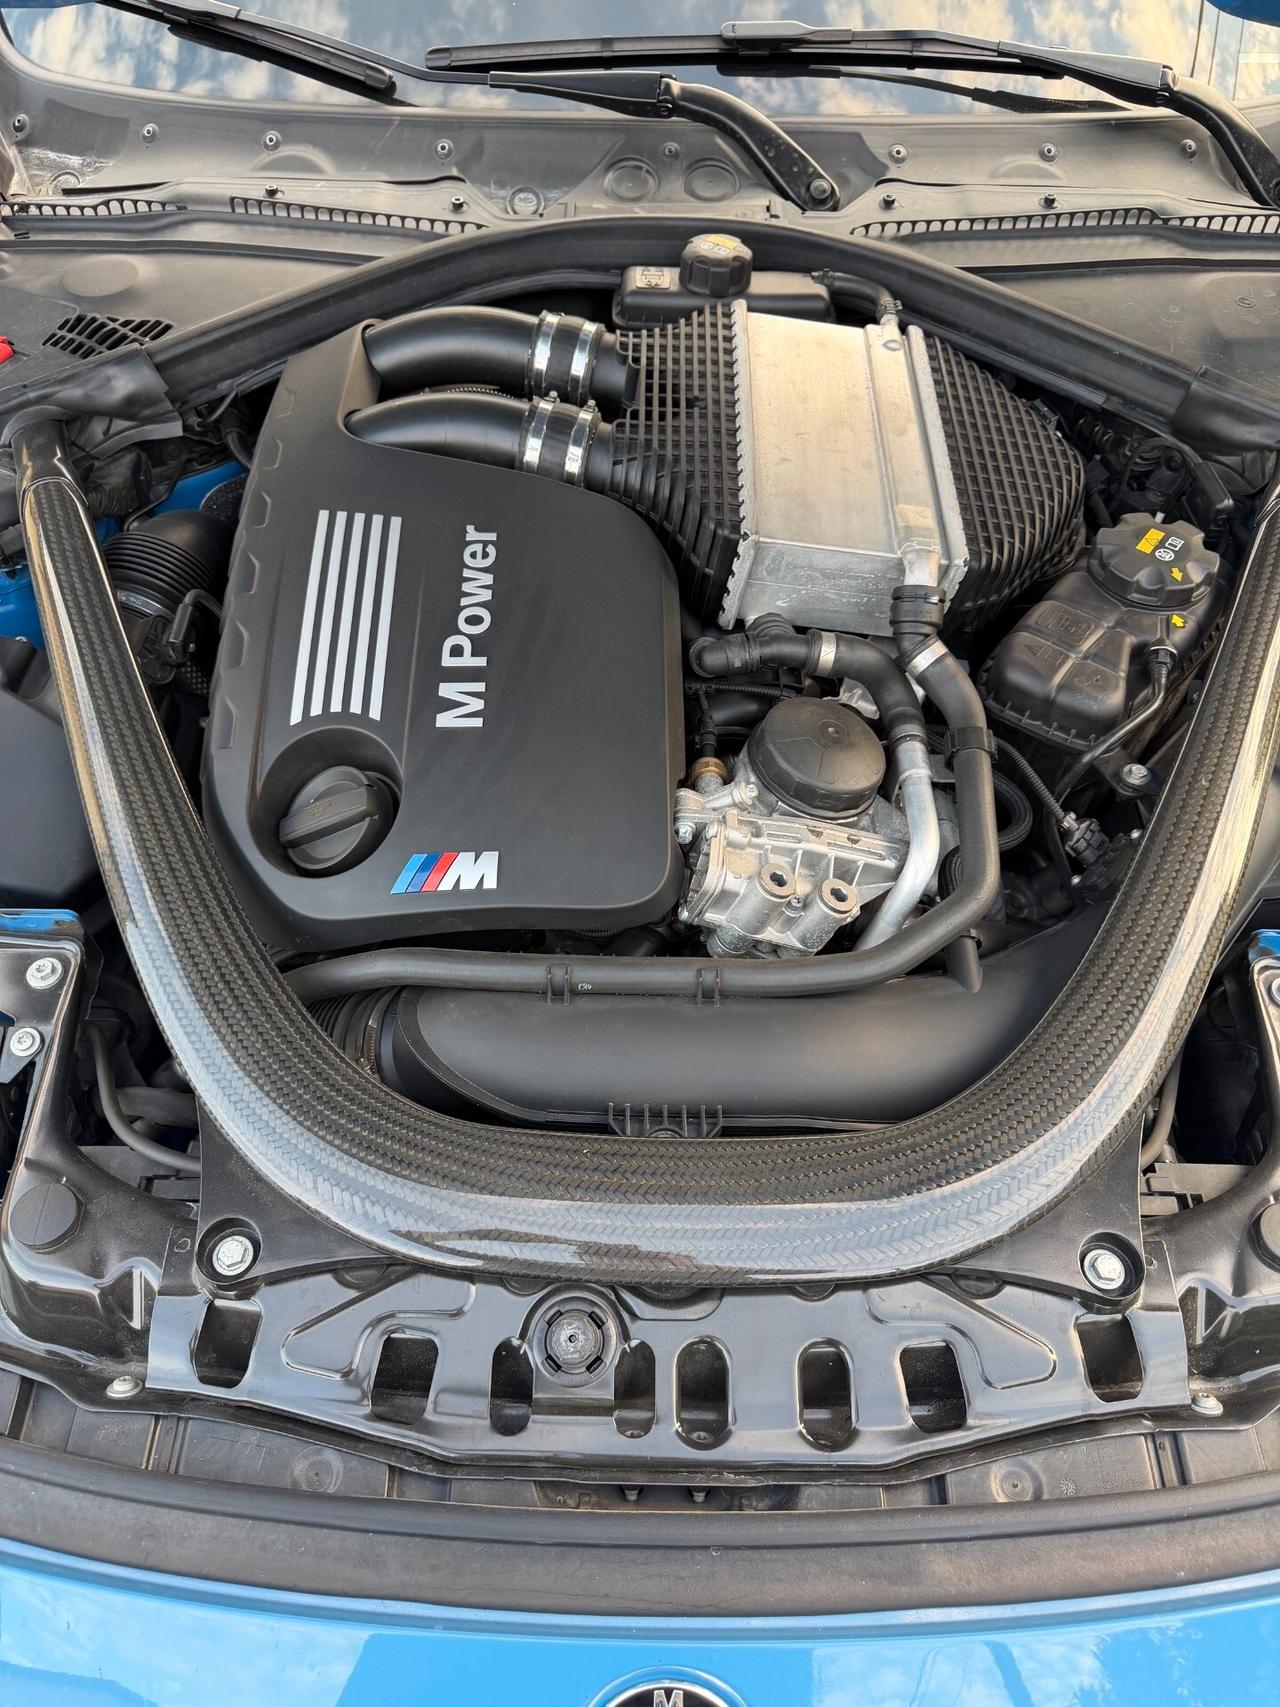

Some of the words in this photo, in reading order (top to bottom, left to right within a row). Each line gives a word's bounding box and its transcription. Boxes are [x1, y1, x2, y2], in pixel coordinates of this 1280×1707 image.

[441, 524, 497, 666] Power
[435, 682, 485, 727] M
[437, 851, 499, 891] M
